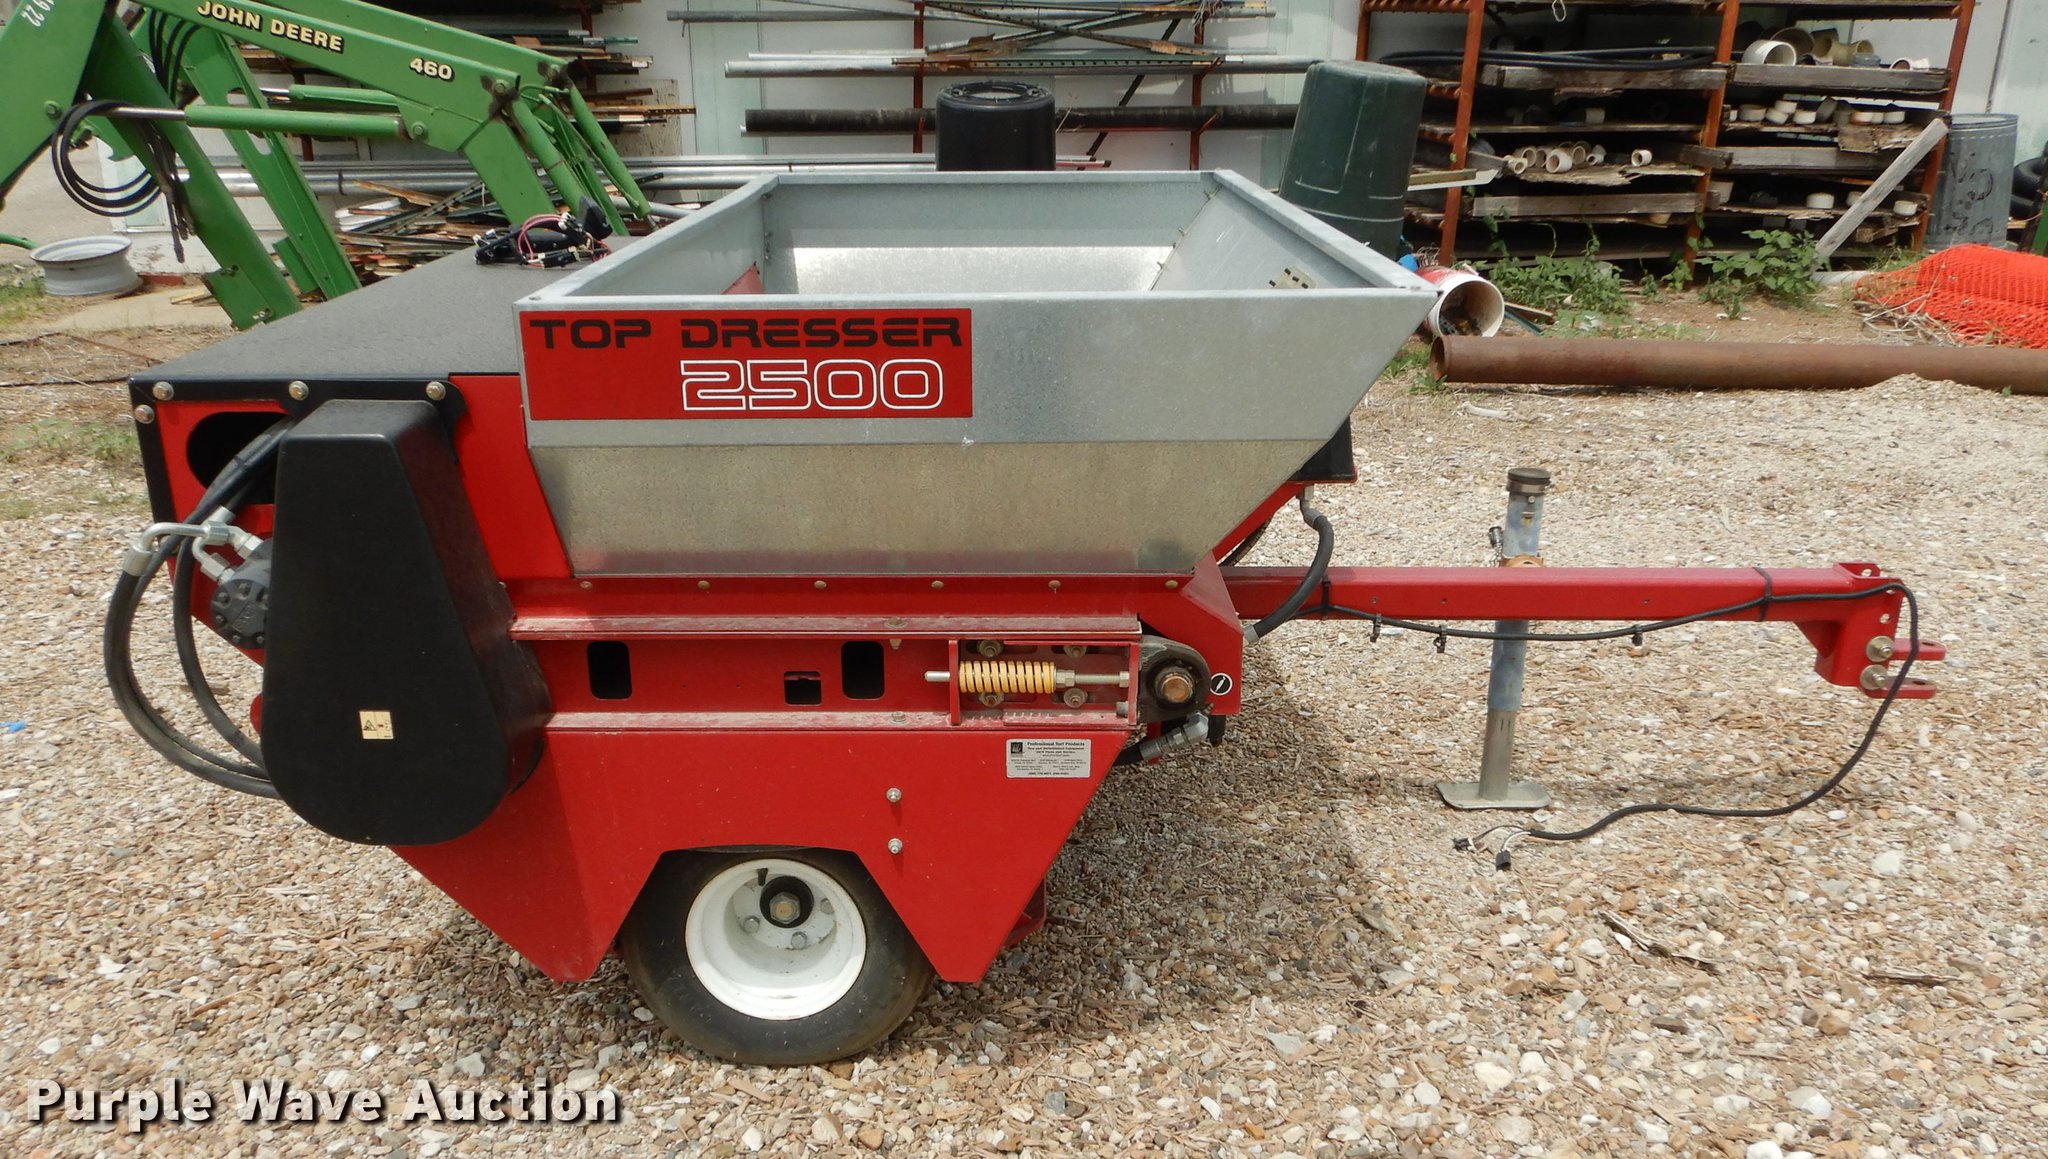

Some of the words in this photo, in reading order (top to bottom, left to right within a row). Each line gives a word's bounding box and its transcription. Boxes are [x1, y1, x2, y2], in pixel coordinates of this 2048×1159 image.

[197, 0, 261, 31] JOHN
[270, 19, 344, 53] DEERE
[409, 57, 454, 82] 460
[529, 319, 651, 349] TOP
[680, 317, 962, 348] DRESSER
[679, 358, 943, 411] 2500
